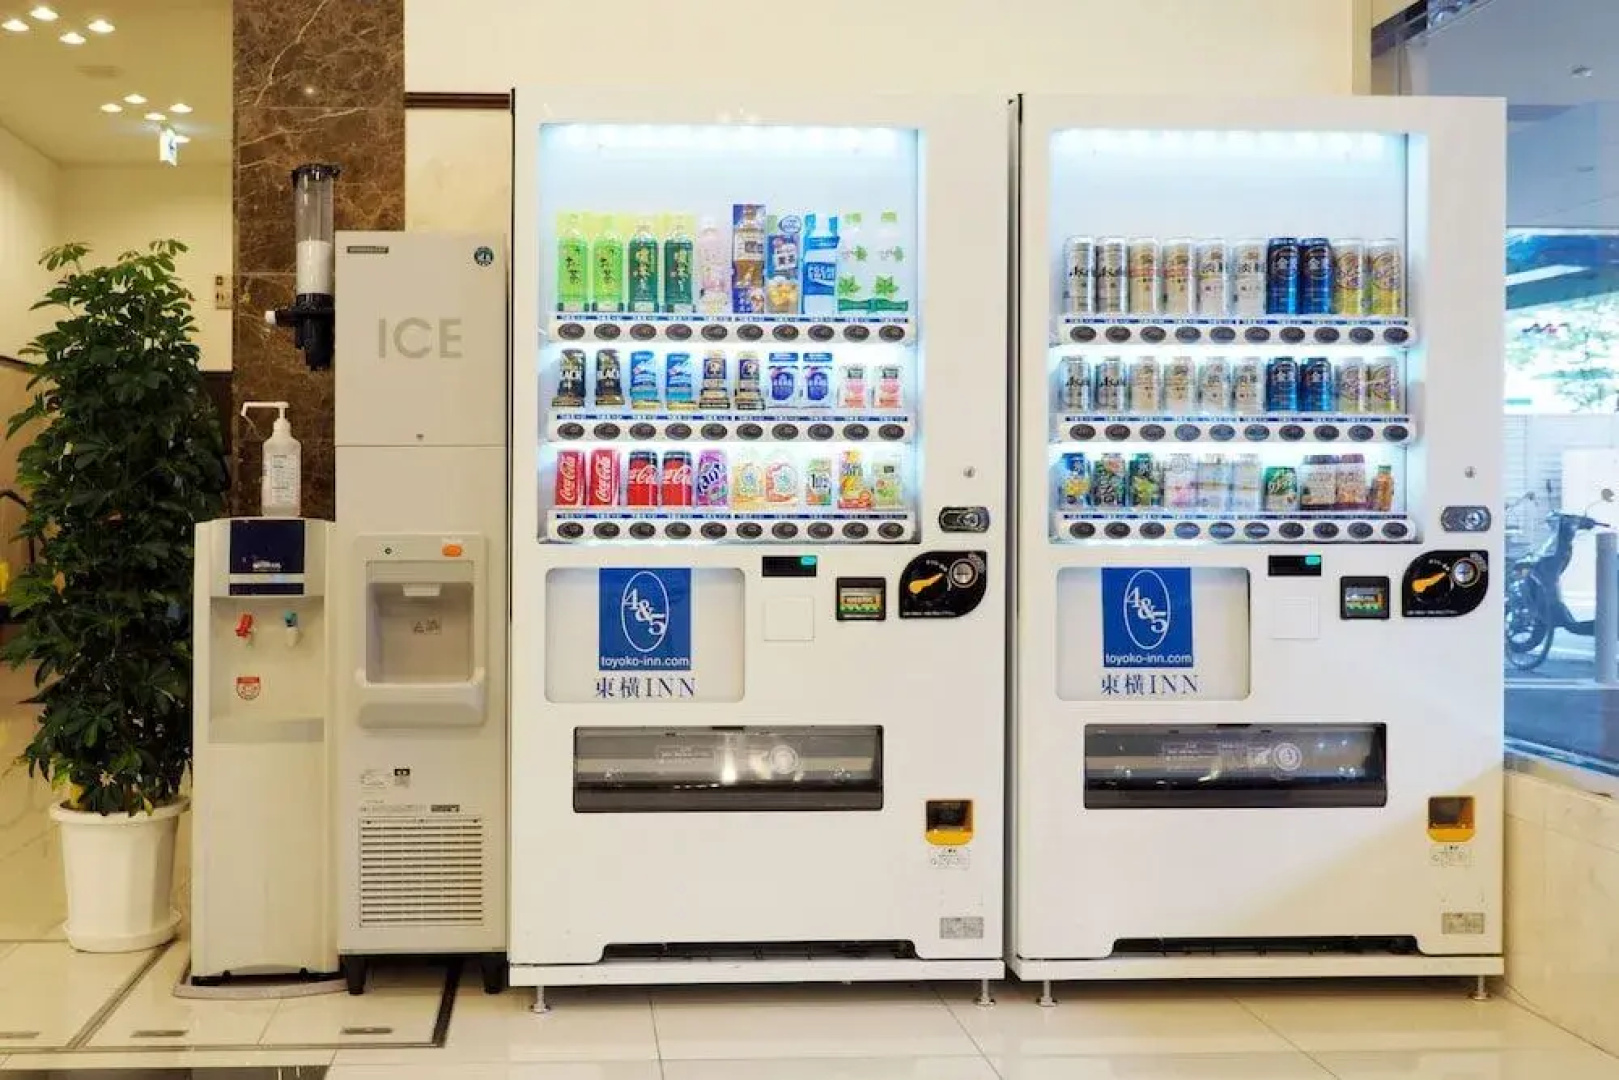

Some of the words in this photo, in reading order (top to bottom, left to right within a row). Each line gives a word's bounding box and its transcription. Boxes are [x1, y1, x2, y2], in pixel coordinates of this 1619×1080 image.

[378, 317, 463, 359] ICE
[560, 454, 576, 502] Coca-Cola
[595, 453, 611, 502] Coca-Cola
[624, 588, 666, 636] 4&5
[1127, 586, 1167, 634] 4&5
[601, 655, 689, 669] toyoko-inn.com
[1105, 652, 1193, 666] toyoko-inn.com
